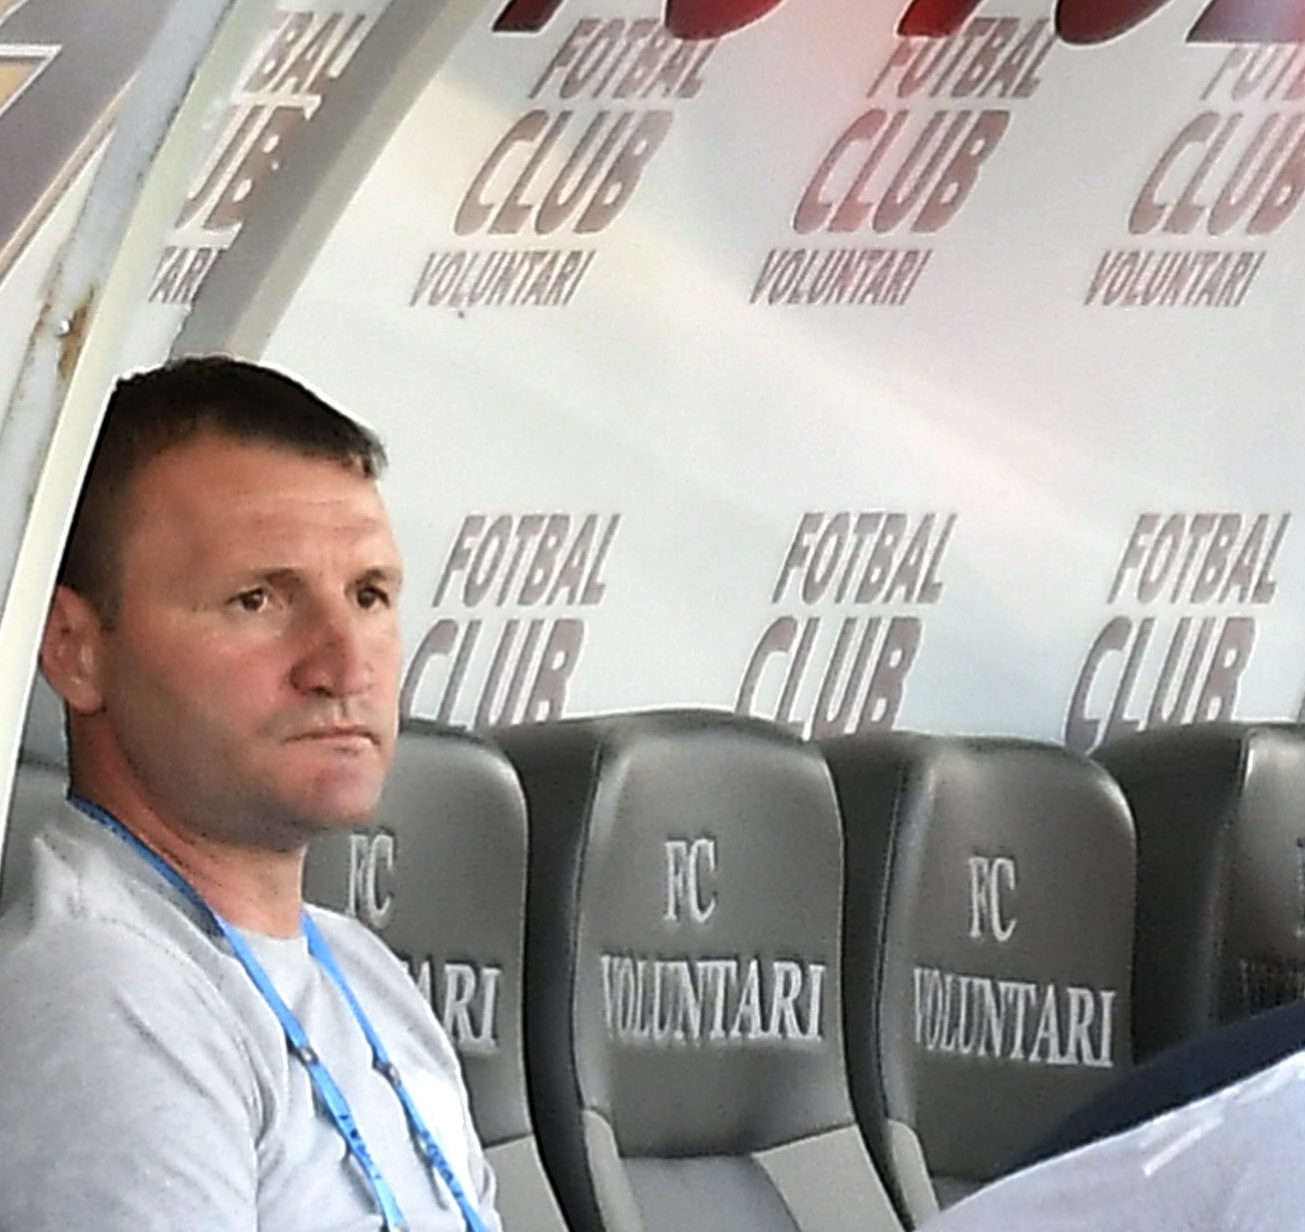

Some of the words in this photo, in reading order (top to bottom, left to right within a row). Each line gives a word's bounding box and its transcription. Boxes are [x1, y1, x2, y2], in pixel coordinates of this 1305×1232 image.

[527, 18, 716, 99] FOTBAL
[453, 109, 673, 235] CLUB
[793, 109, 1011, 233] CLUB
[409, 251, 597, 306] VOLUNTARI
[750, 249, 934, 305] VOLUNTARI
[1084, 250, 1266, 307] VOLUNTARI
[432, 513, 622, 607] FOTBAL
[771, 511, 958, 604] FOTBAL
[1106, 512, 1292, 604] FOTBAL
[1064, 615, 1257, 748] CLUB
[664, 837, 716, 923] FC
[968, 856, 1018, 942] FC
[600, 955, 827, 1045] VOLUNTARI
[913, 967, 1117, 1068] VOLUNTARI
